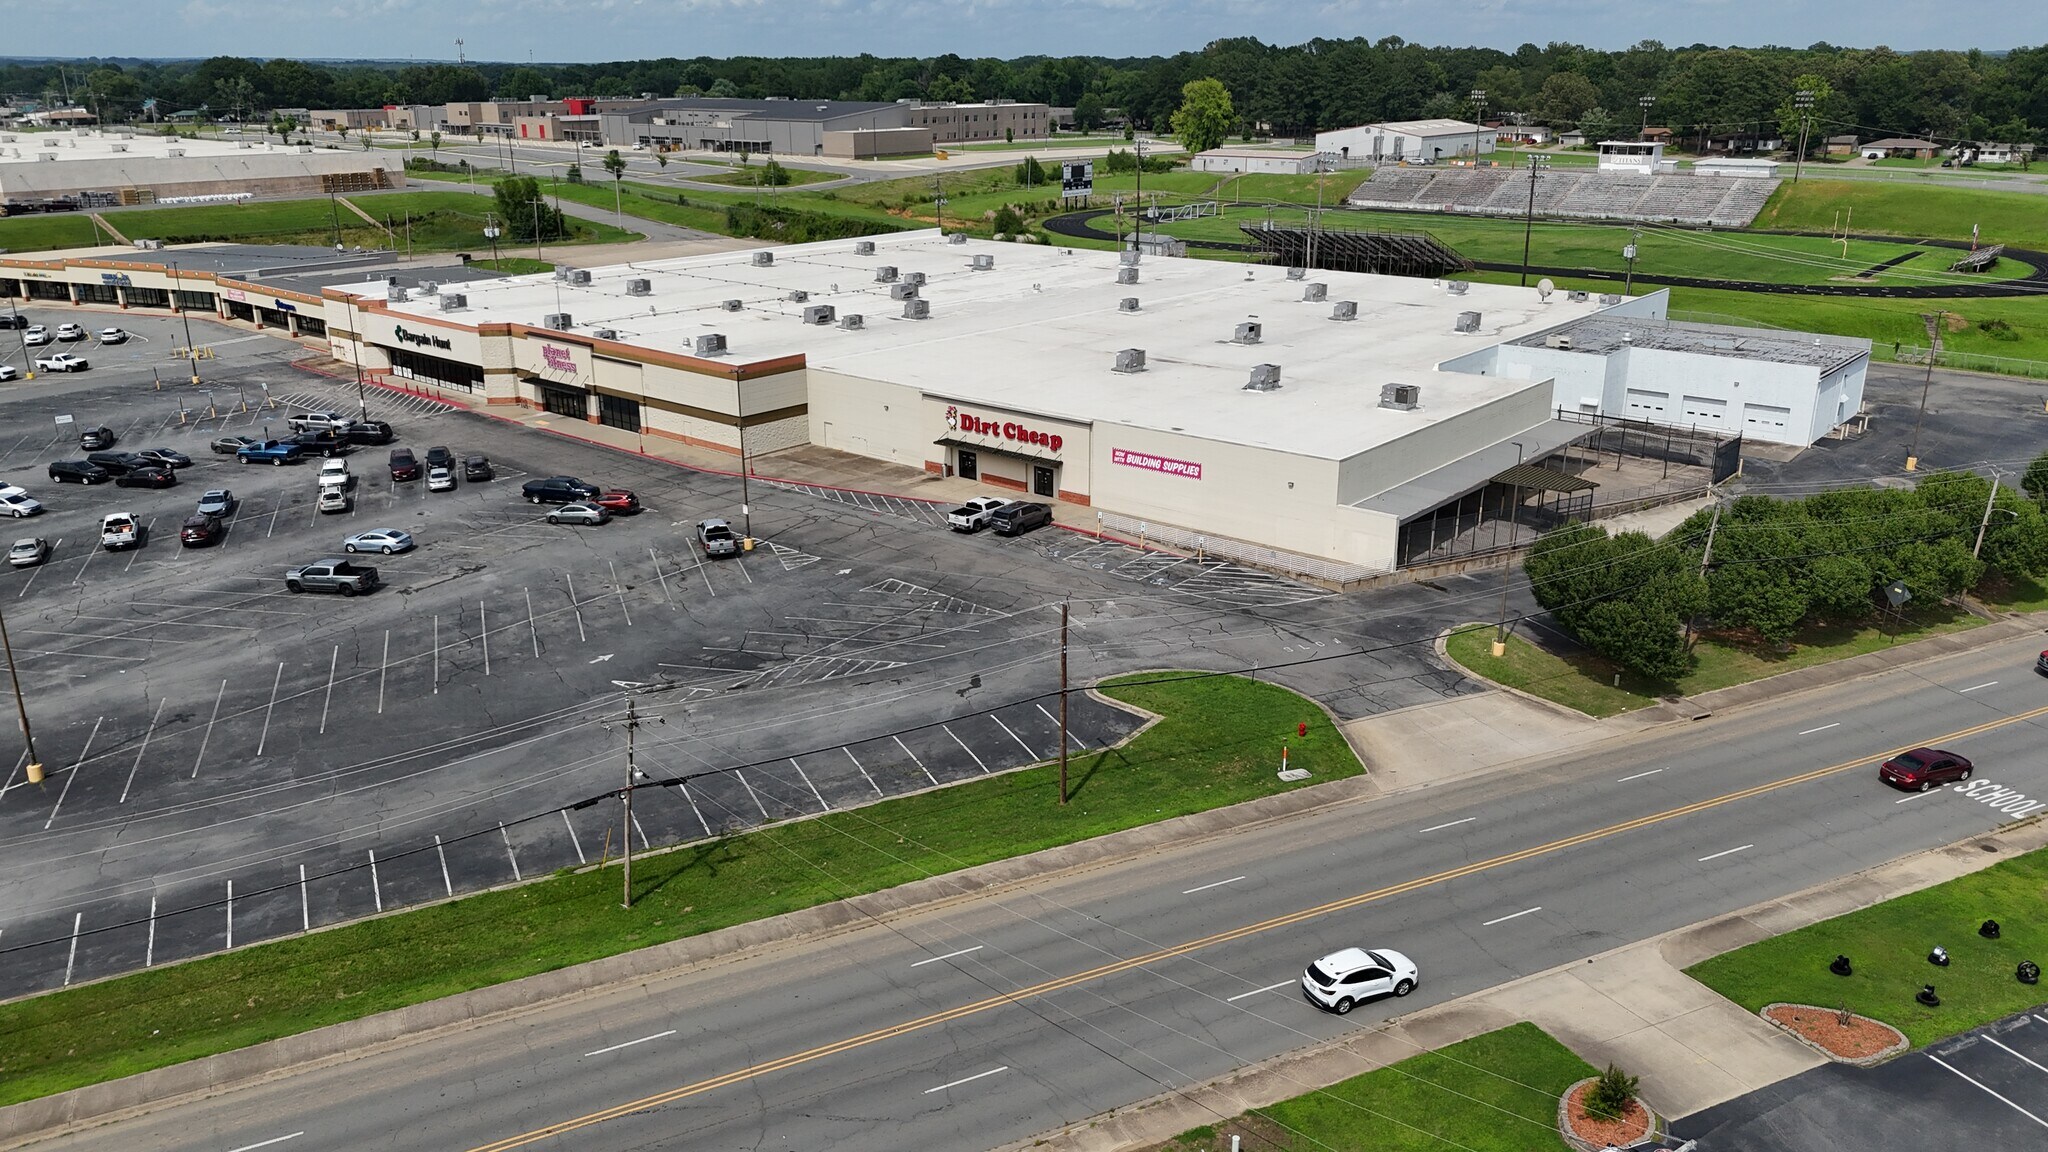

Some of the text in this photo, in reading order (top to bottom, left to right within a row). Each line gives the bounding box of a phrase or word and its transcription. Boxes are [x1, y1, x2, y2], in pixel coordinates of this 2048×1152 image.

[402, 329, 452, 351] Bargain Hunt
[960, 413, 1063, 452] Dirt Cheap
[1126, 454, 1200, 476] BUILDING SUPPLIES
[1954, 779, 2046, 819] SCHOOL
